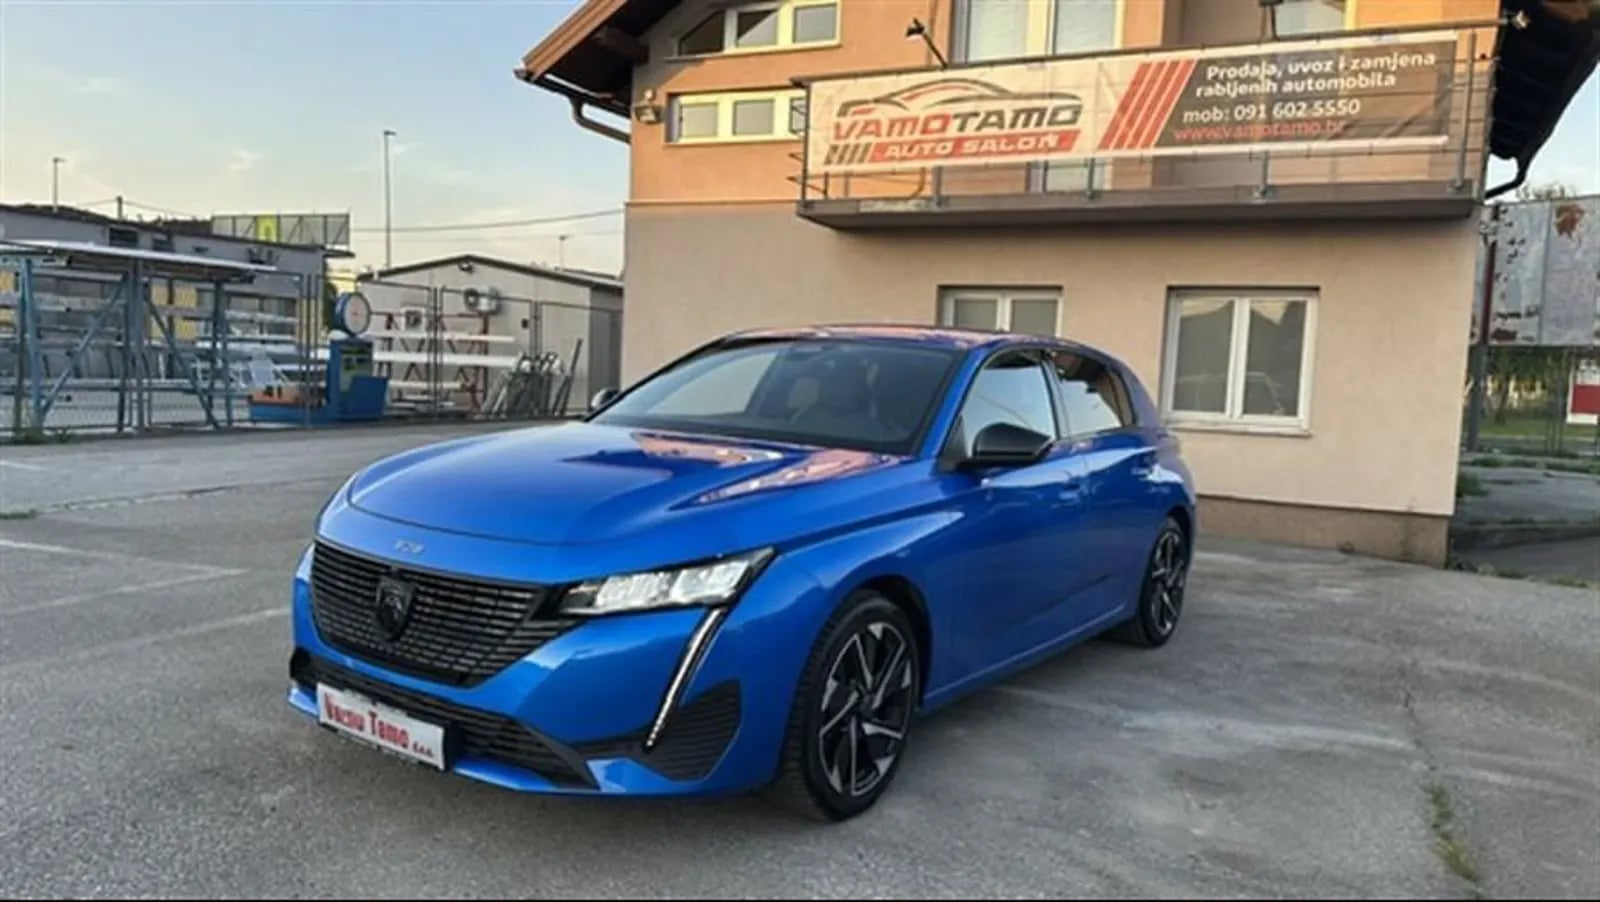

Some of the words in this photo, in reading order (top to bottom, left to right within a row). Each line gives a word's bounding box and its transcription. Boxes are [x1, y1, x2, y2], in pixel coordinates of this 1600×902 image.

[1207, 61, 1282, 81] Prodaja,
[1287, 59, 1334, 75] uvoz
[1349, 52, 1436, 71] zamjena
[1196, 78, 1278, 98] rabljenih
[1282, 72, 1396, 93] automobila
[832, 103, 1083, 141] VAMOTAMO
[1183, 106, 1229, 123] mob:
[1233, 103, 1267, 121] 091
[1272, 101, 1307, 118] 602
[1311, 98, 1361, 116] 5550
[884, 142, 953, 159] AUTO
[960, 133, 1060, 155] SALON
